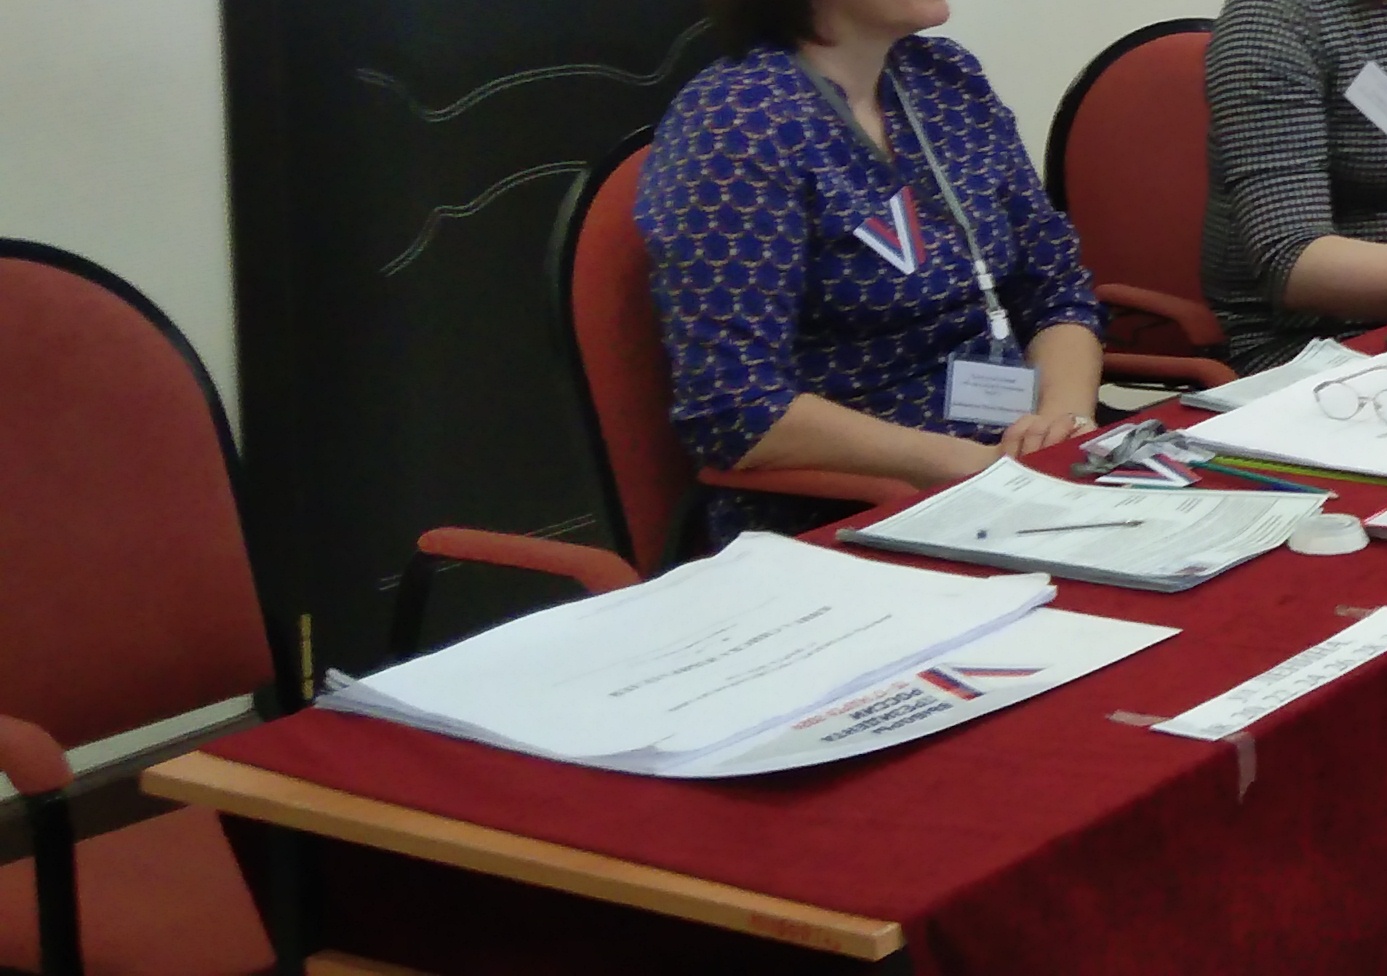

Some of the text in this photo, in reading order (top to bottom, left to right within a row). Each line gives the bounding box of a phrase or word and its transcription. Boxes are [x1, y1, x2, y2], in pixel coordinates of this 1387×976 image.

[819, 694, 938, 743] ПРЕЗИДЕНТА
[849, 687, 924, 720] РОССИИ
[871, 701, 954, 735] ВЫБОРЫ
